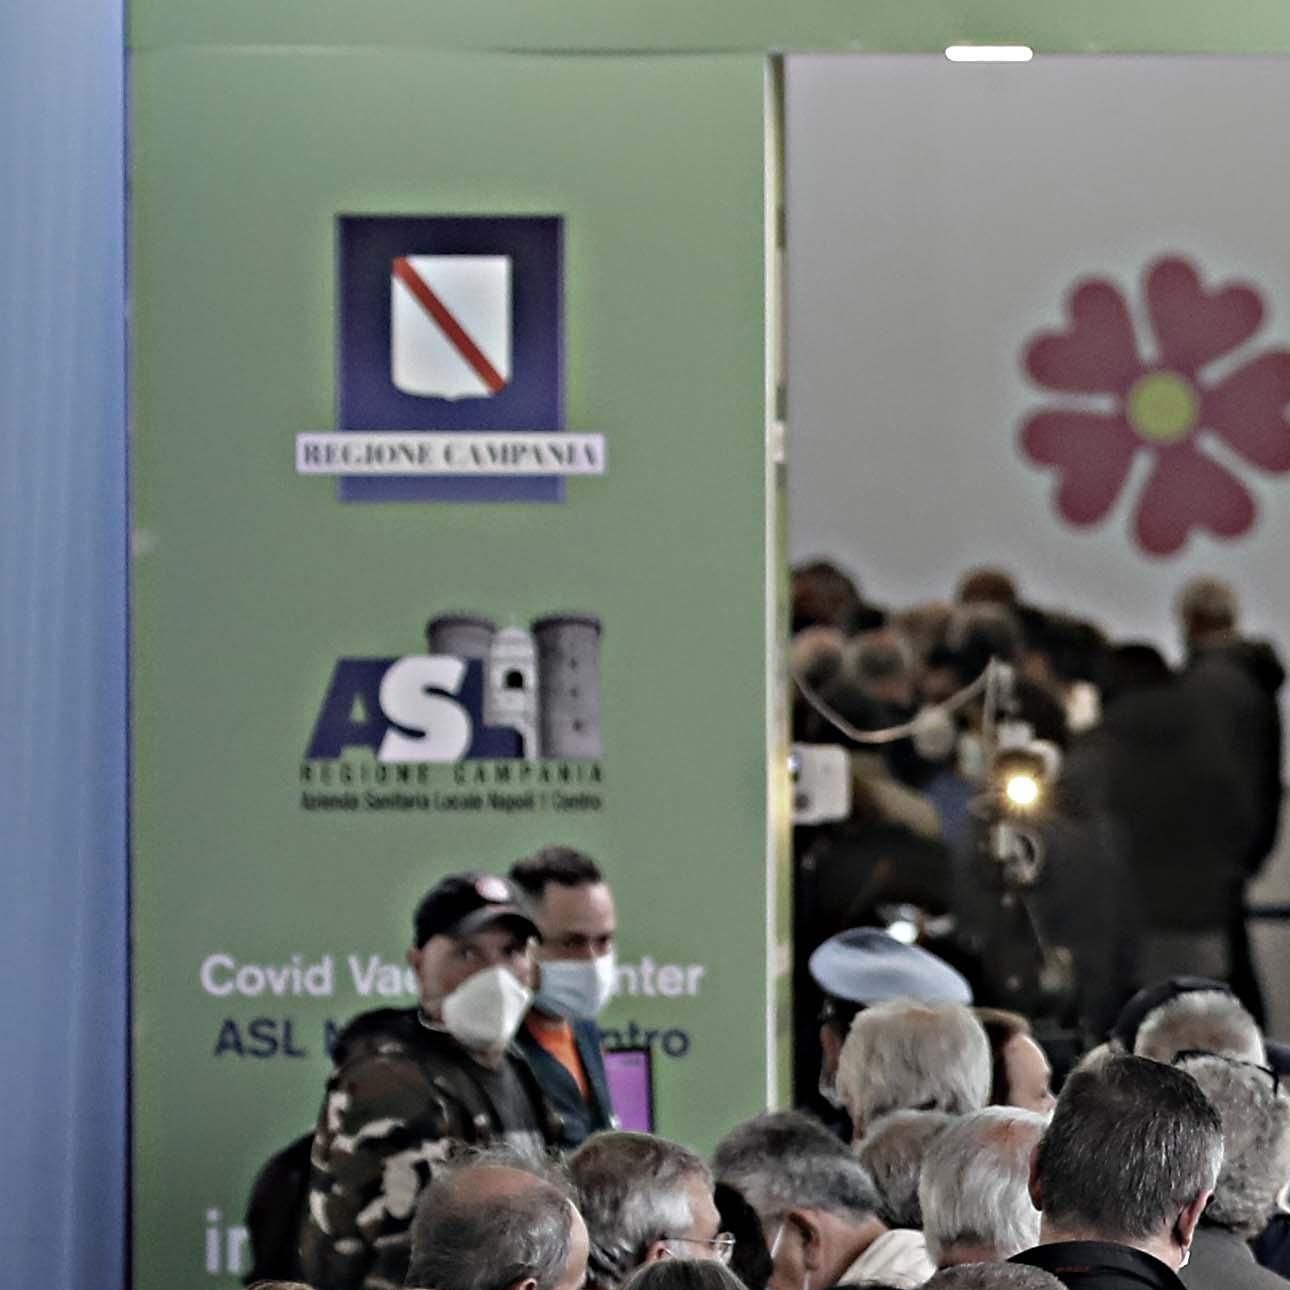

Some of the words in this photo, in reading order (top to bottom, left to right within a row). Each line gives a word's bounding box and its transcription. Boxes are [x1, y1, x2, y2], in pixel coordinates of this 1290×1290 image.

[303, 443, 430, 466] REGIONE
[442, 443, 597, 466] CAMPANIA
[305, 656, 525, 762] ASL
[302, 763, 430, 784] REGIONE
[453, 763, 602, 784] CAMPANIA
[200, 953, 334, 995] Covid
[213, 1018, 306, 1059] ASL
